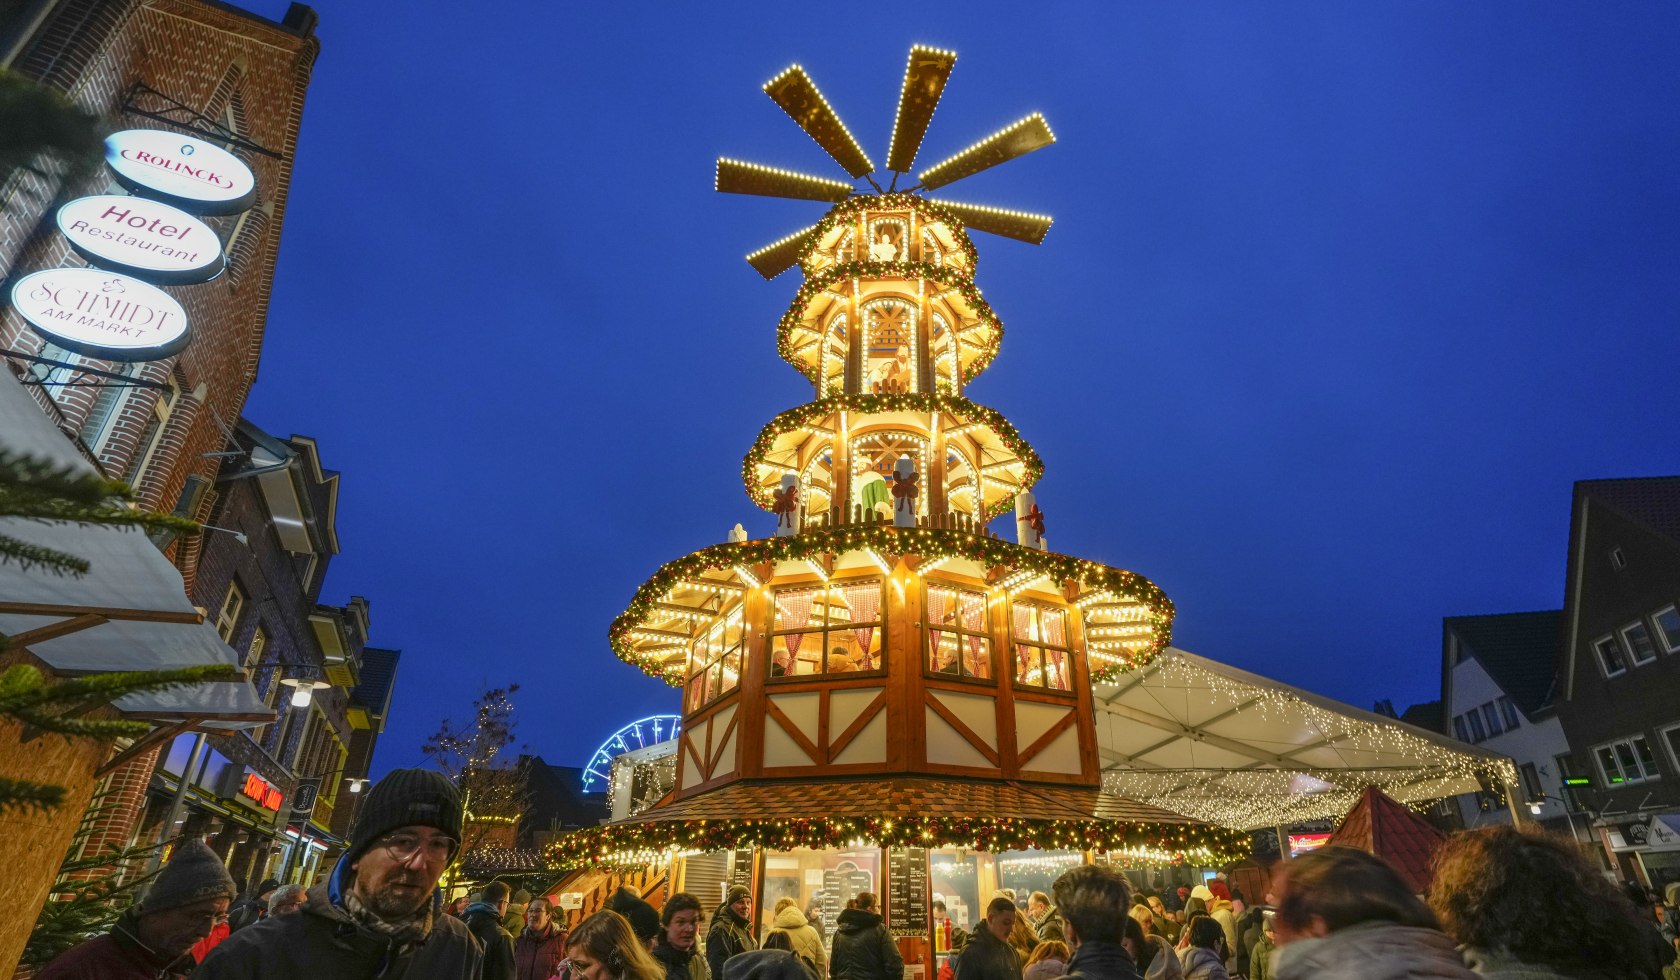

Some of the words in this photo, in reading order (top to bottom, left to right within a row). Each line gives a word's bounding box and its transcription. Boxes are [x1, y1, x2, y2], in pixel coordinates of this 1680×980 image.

[136, 151, 222, 184] ROLINCK
[100, 205, 192, 240] Hotel
[69, 220, 199, 263] Restaurant
[30, 281, 174, 331] SCHMIDT
[41, 308, 74, 321] AM
[77, 316, 147, 339] MARKT
